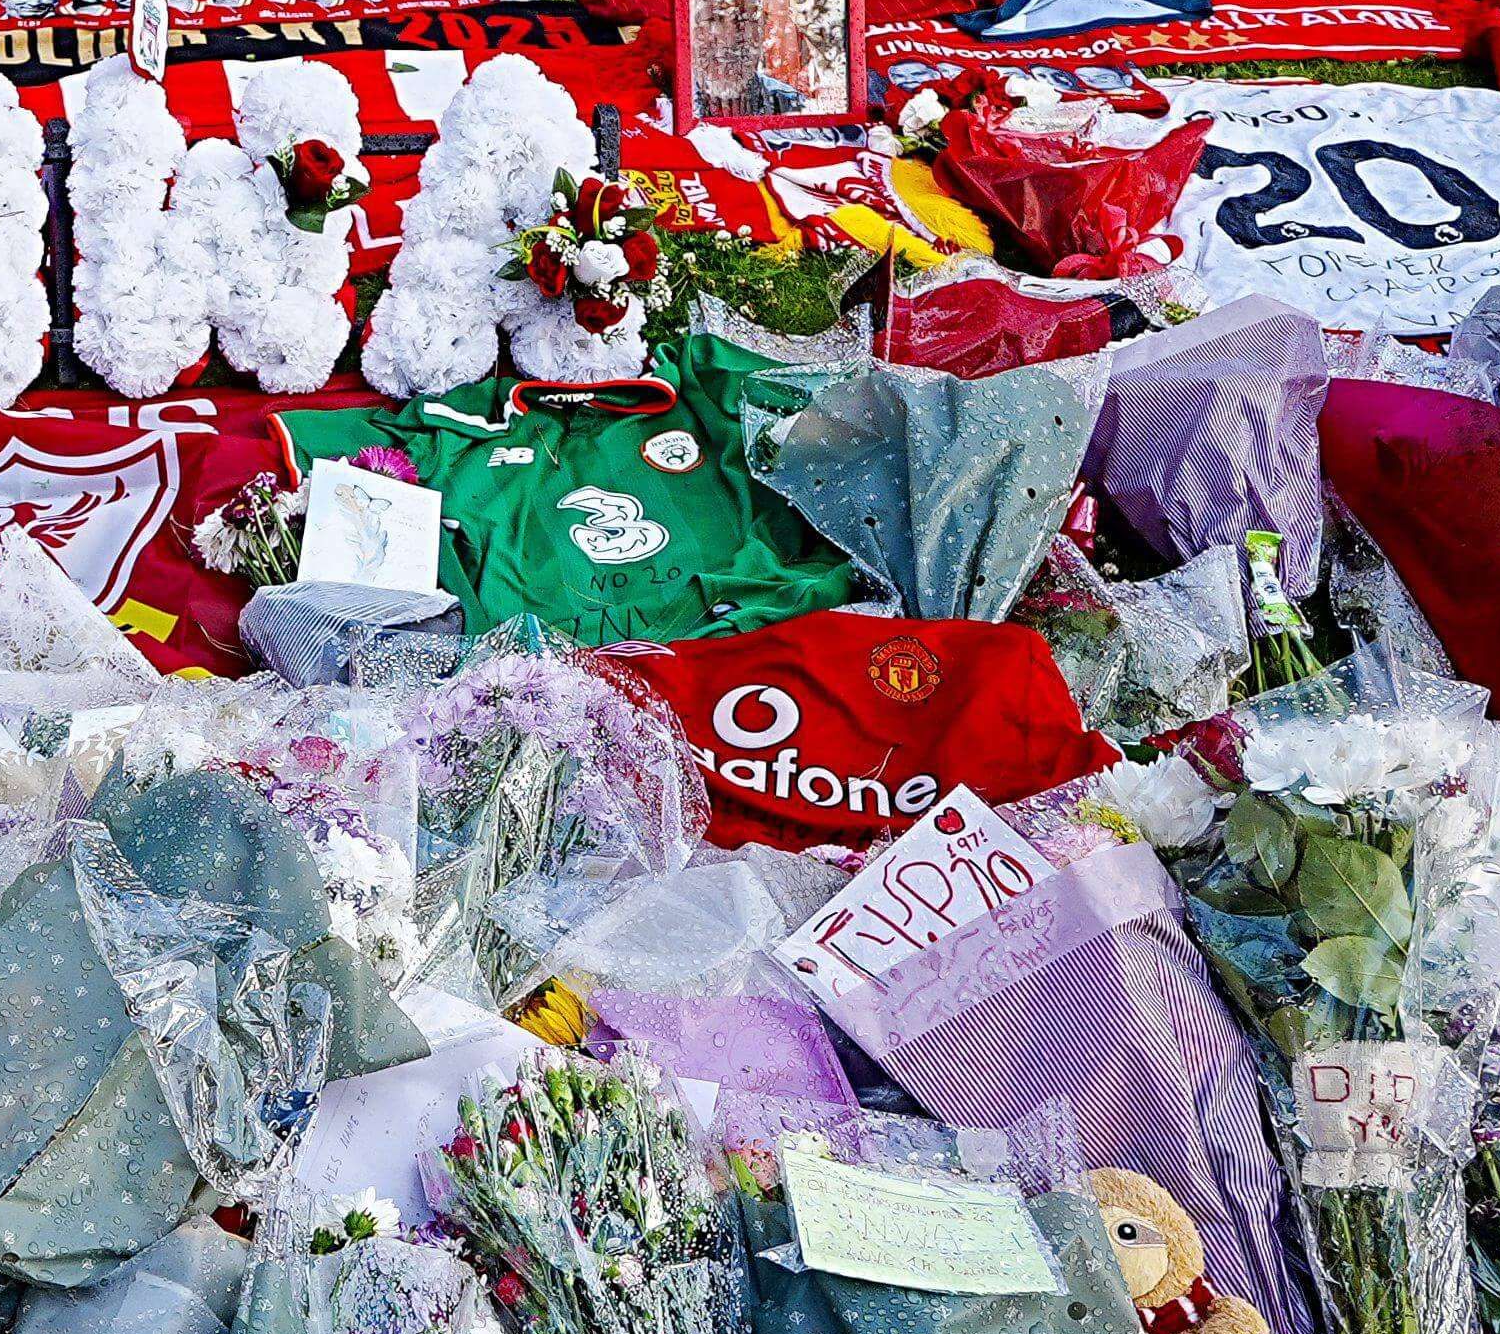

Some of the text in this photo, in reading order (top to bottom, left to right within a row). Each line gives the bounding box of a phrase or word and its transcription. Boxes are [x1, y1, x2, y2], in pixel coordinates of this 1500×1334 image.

[395, 11, 590, 53] 2025
[1299, 7, 1451, 32] ALONE
[590, 564, 685, 592] NO 20
